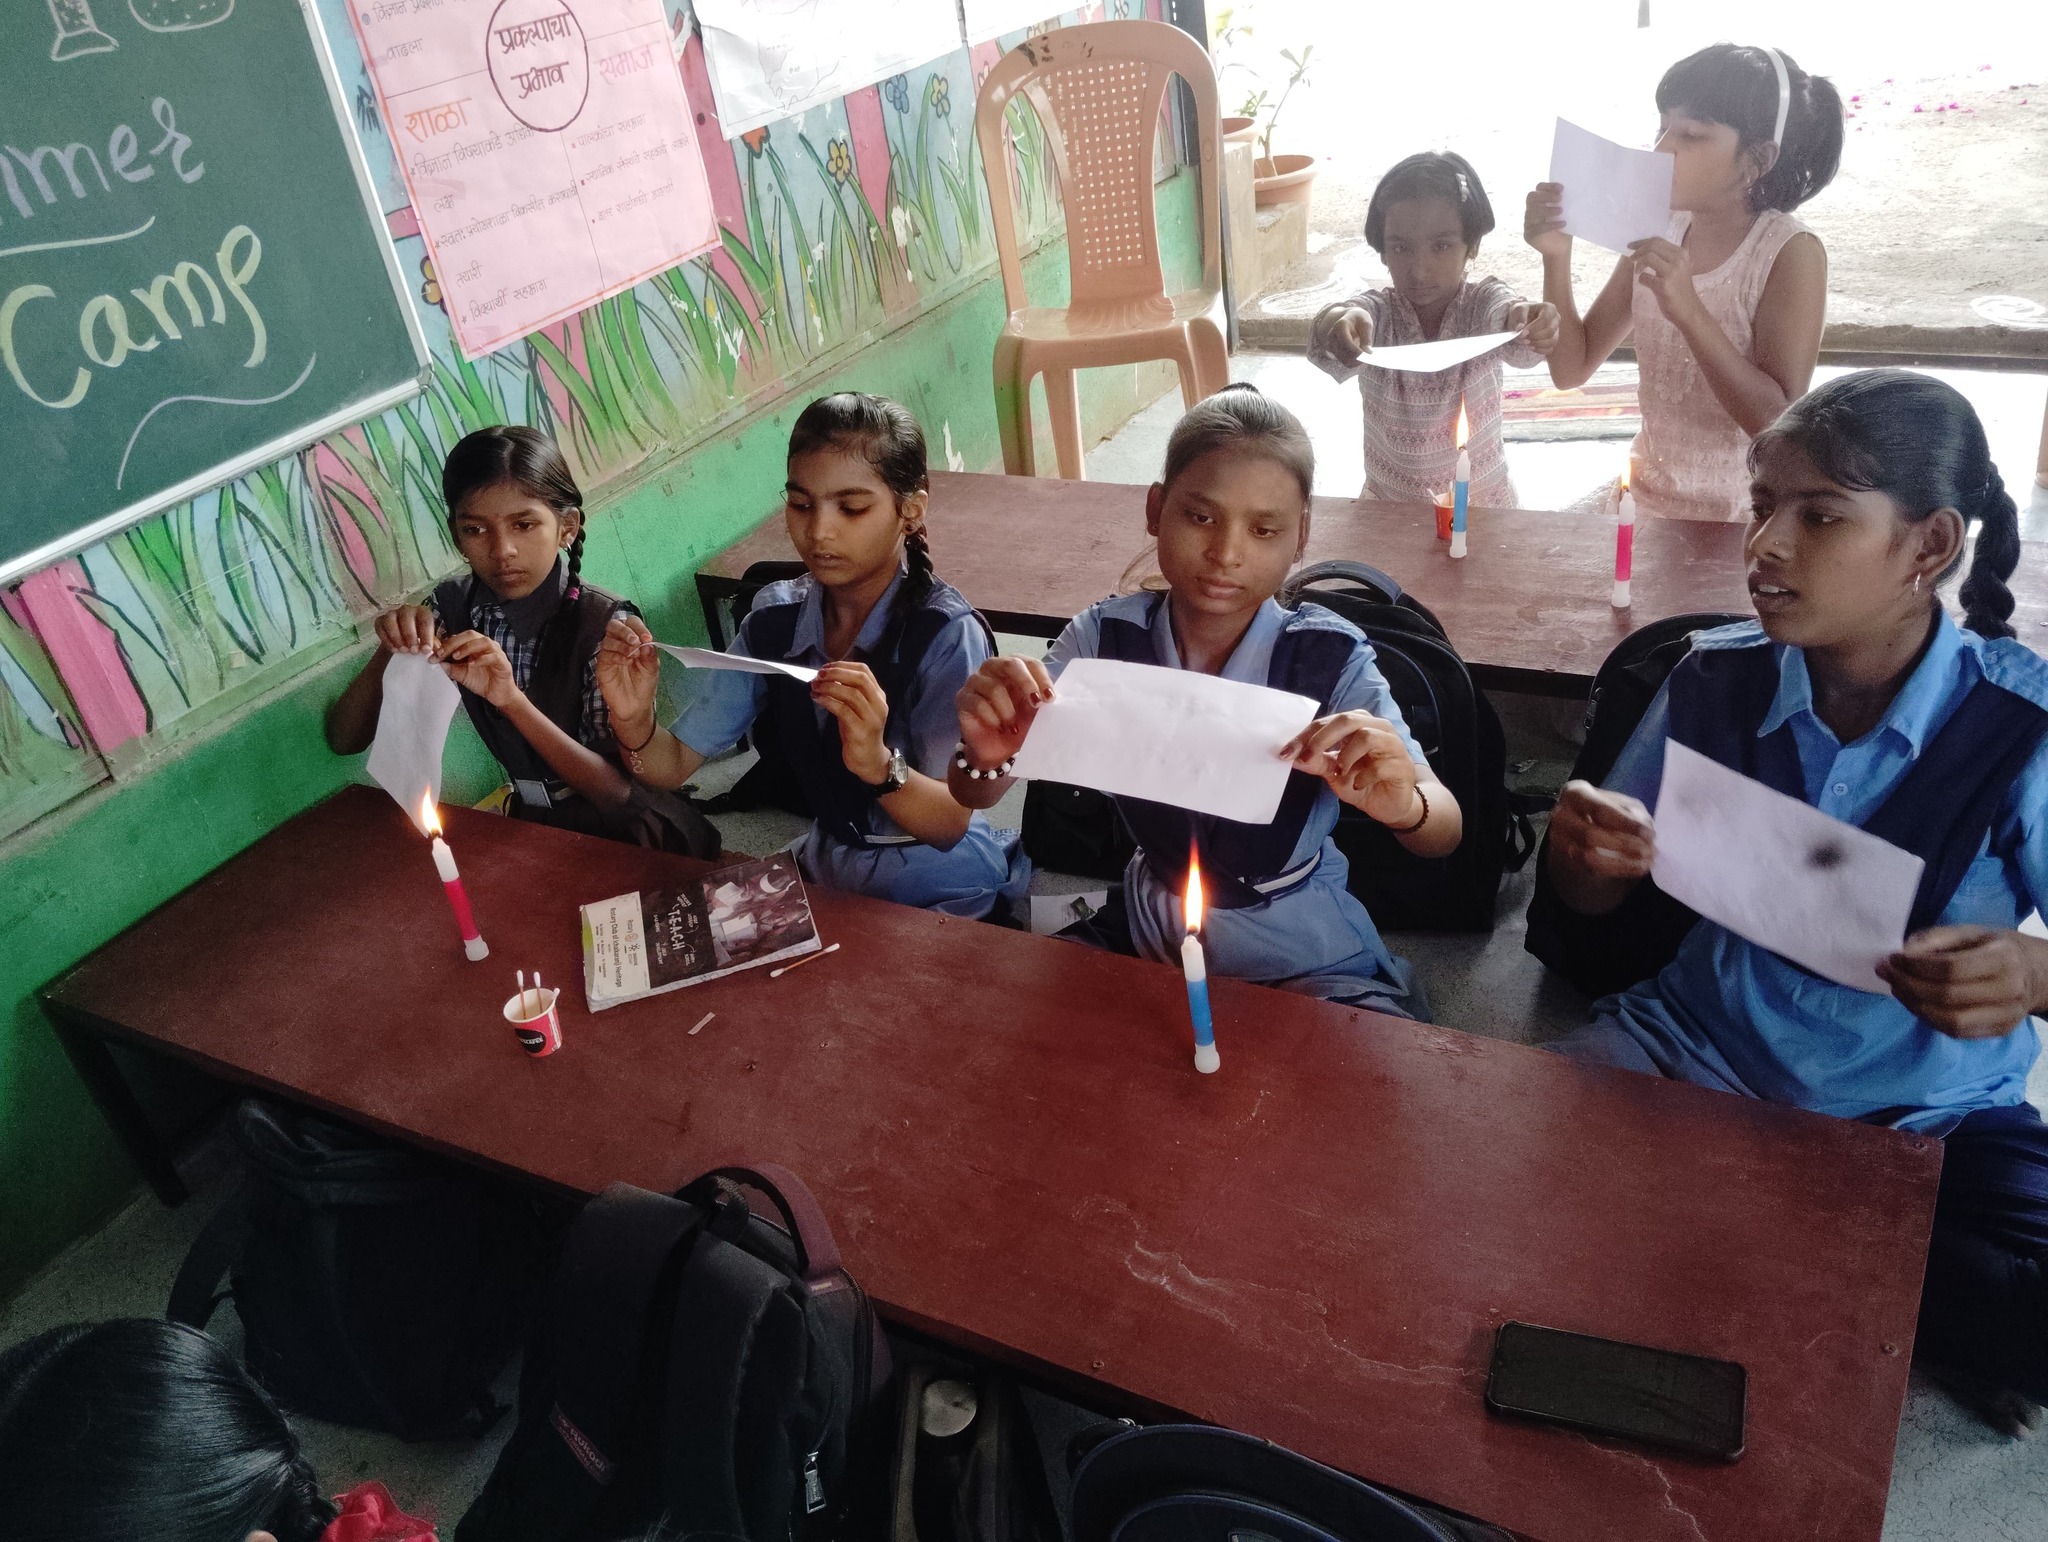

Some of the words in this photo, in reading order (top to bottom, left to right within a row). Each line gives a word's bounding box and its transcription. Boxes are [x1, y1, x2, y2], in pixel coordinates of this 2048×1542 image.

[386, 38, 423, 60] वाढला
[494, 12, 572, 55] प्रकल्पाचा
[510, 61, 570, 99] प्रभाव
[593, 40, 661, 85] समाज
[404, 97, 473, 143] शाळा
[413, 152, 454, 180] विज्ञान
[453, 130, 503, 165] विषयाकडे
[2, 225, 268, 408] Camp
